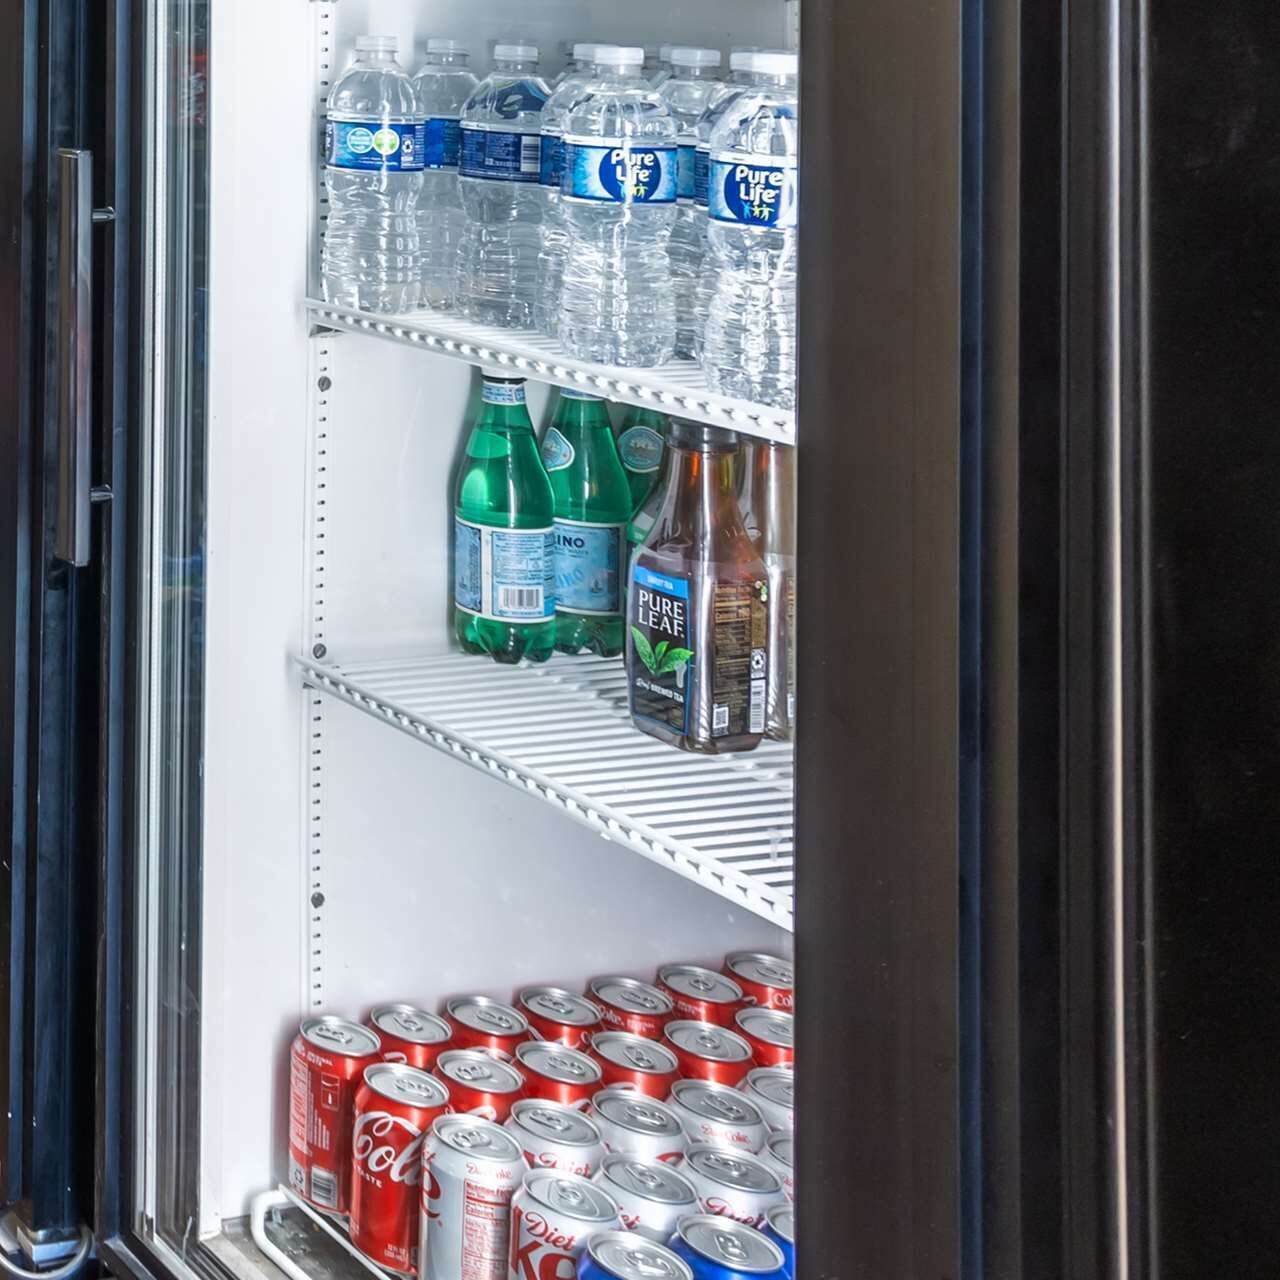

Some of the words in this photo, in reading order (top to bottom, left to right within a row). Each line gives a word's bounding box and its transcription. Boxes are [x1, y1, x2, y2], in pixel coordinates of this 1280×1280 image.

[610, 149, 655, 167] Pure
[615, 166, 650, 185] Life
[735, 166, 784, 187] Pure
[739, 183, 777, 205] Life
[638, 588, 684, 621] PURE
[525, 1211, 576, 1252] Diet
